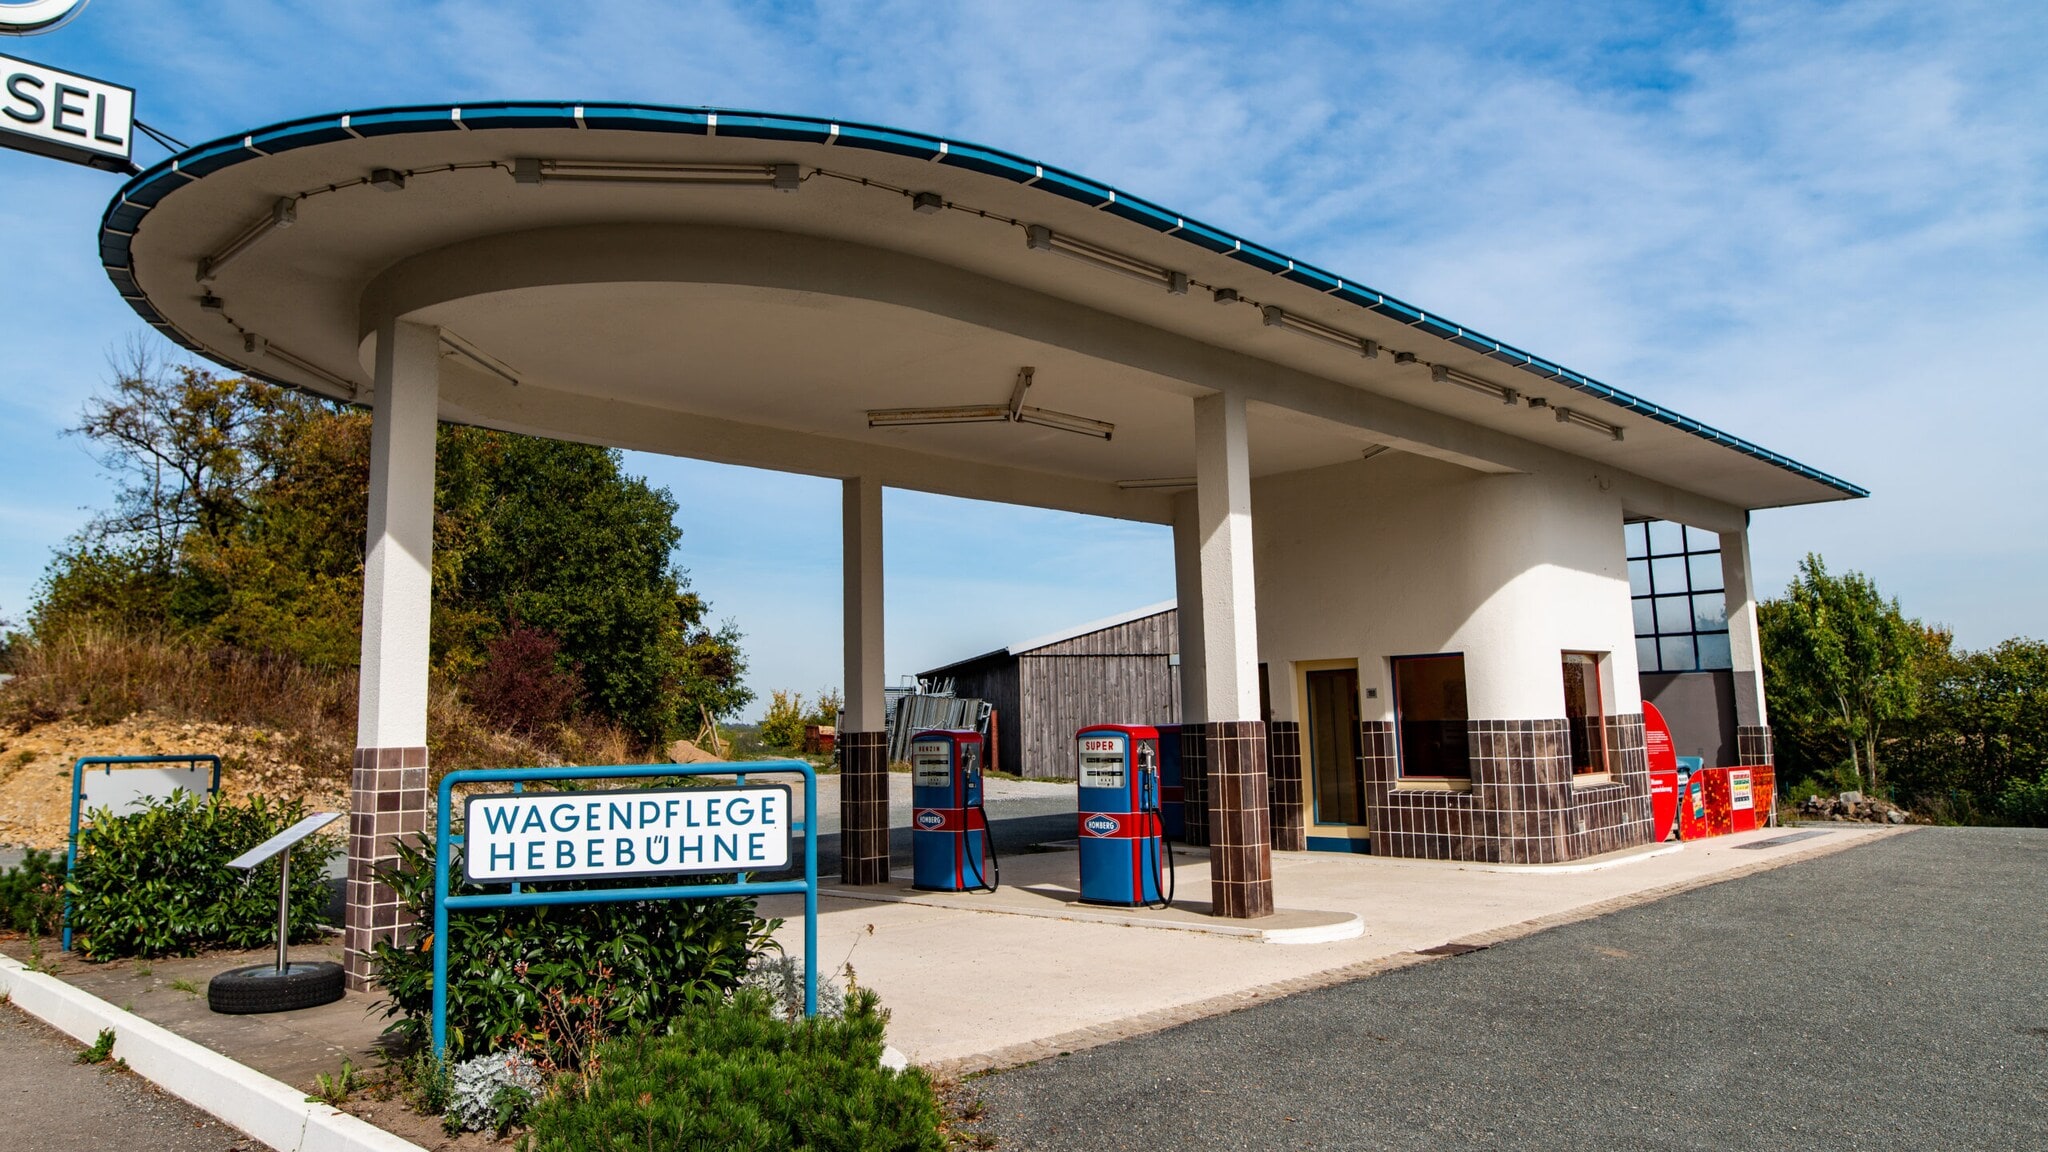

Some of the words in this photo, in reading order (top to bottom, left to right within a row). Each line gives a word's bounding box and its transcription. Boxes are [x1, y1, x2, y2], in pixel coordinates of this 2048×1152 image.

[918, 745, 940, 753] BENZIN
[1085, 740, 1114, 751] SUPER
[483, 796, 776, 835] WAGENPFLEGE
[489, 832, 766, 872] HEBEBÜHNE
